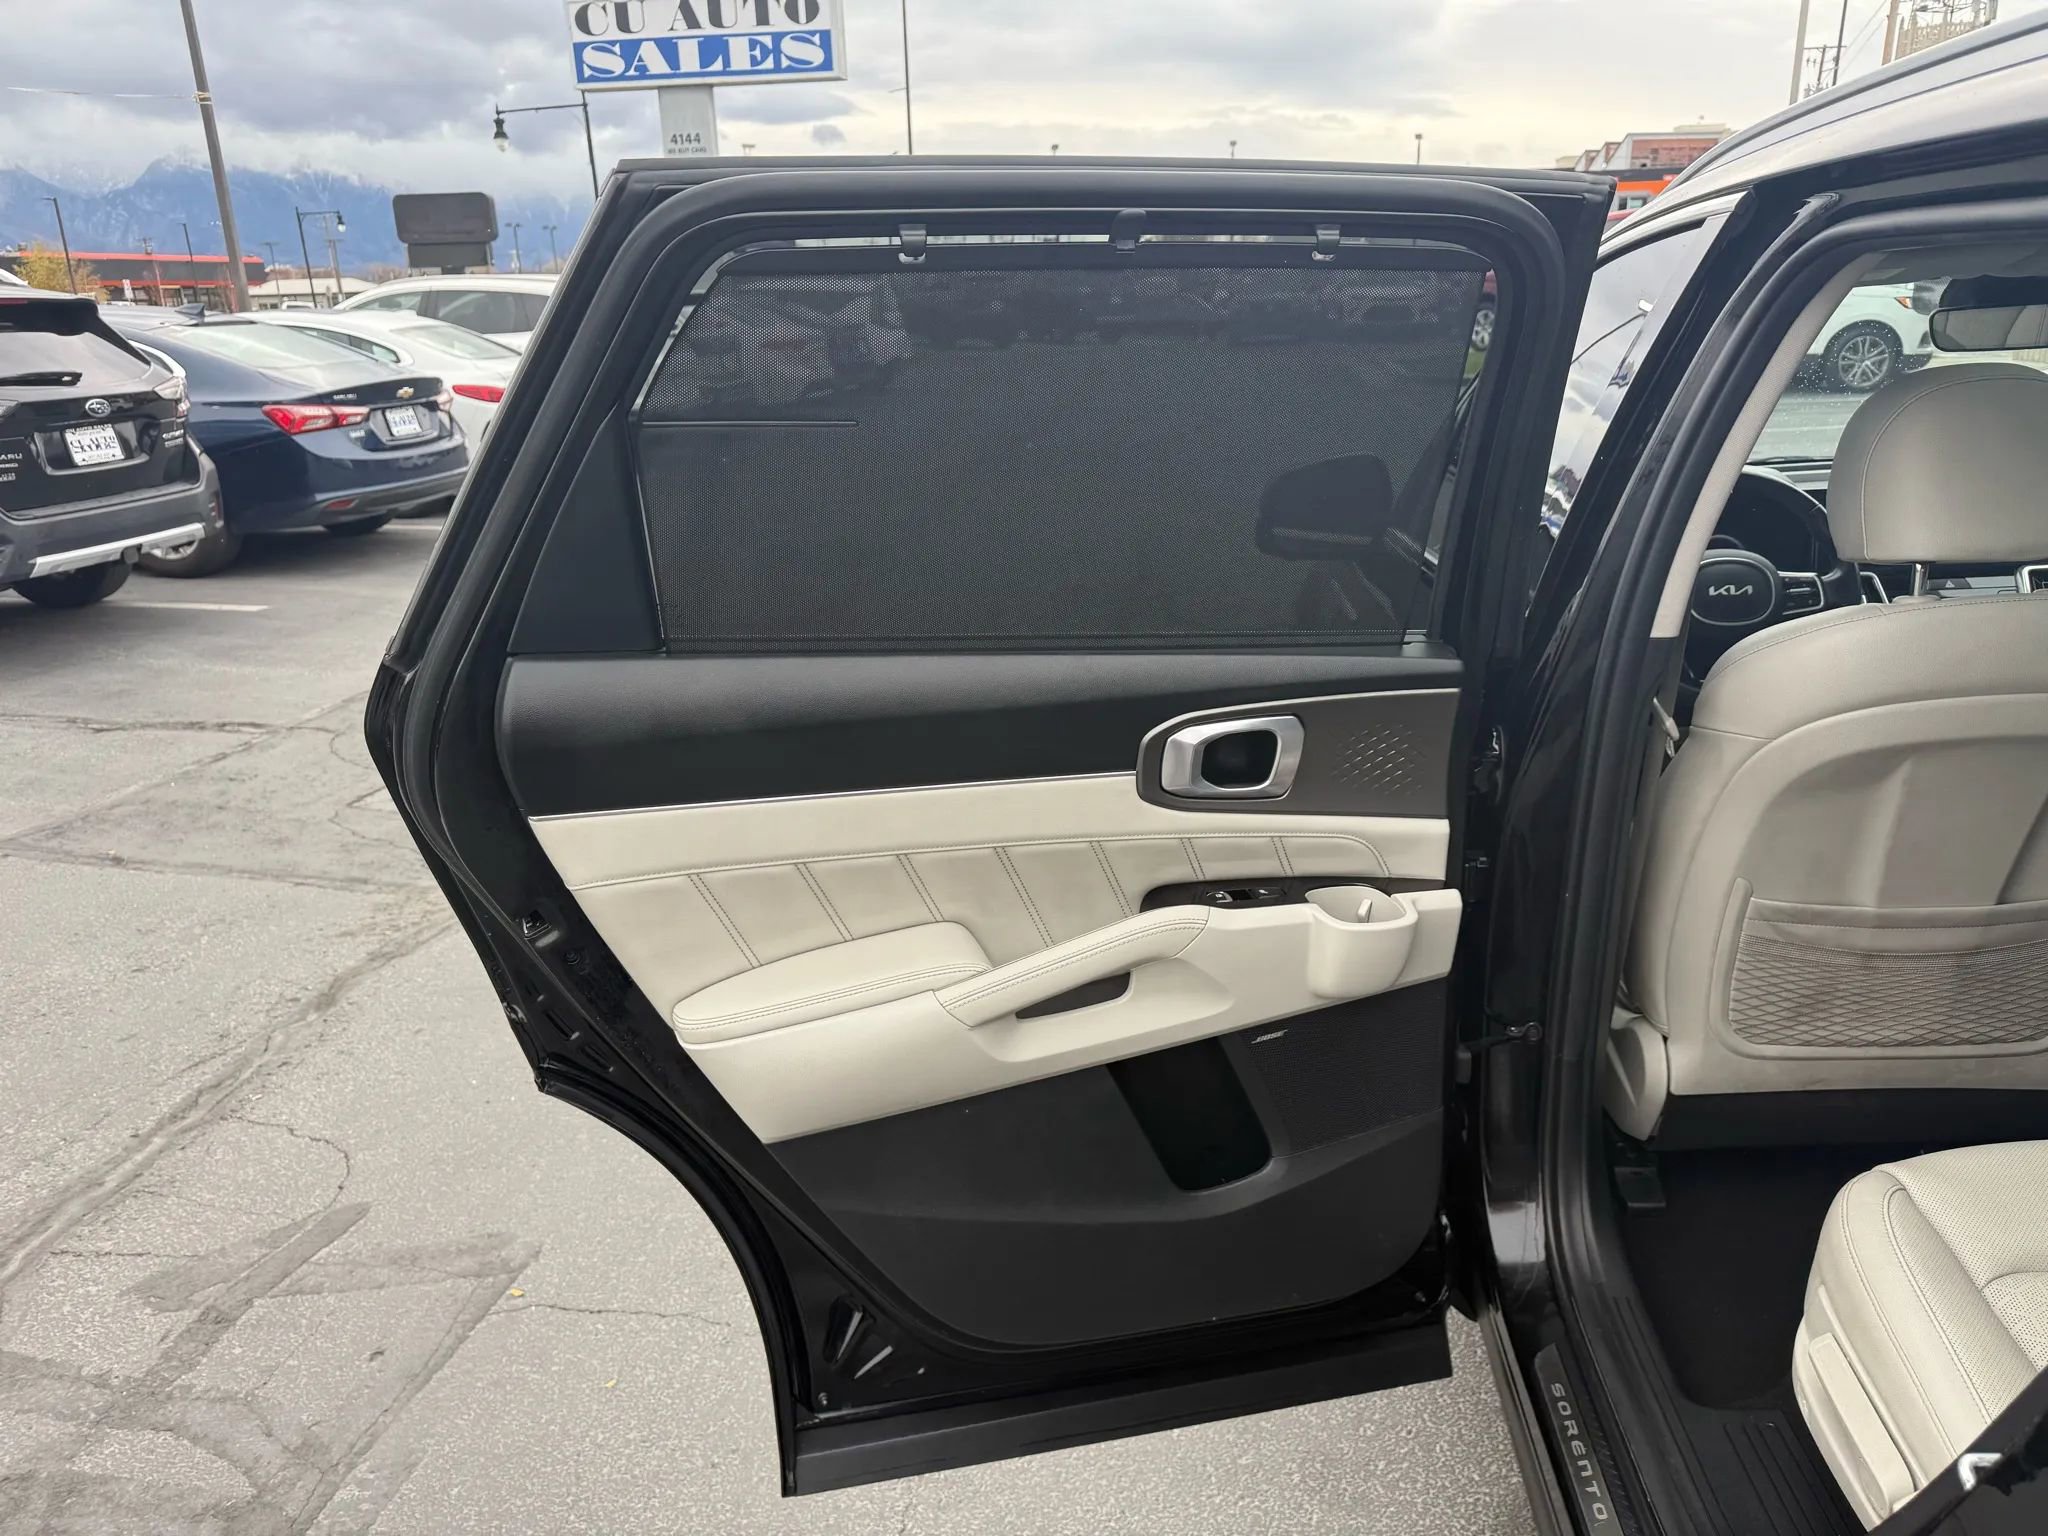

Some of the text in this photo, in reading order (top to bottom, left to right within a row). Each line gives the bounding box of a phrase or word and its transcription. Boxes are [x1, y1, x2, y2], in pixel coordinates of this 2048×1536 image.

[575, 0, 820, 36] CU AUTO
[582, 32, 826, 78] SALES
[670, 132, 701, 145] 4144
[1551, 1383, 1609, 1520] SORENTO
